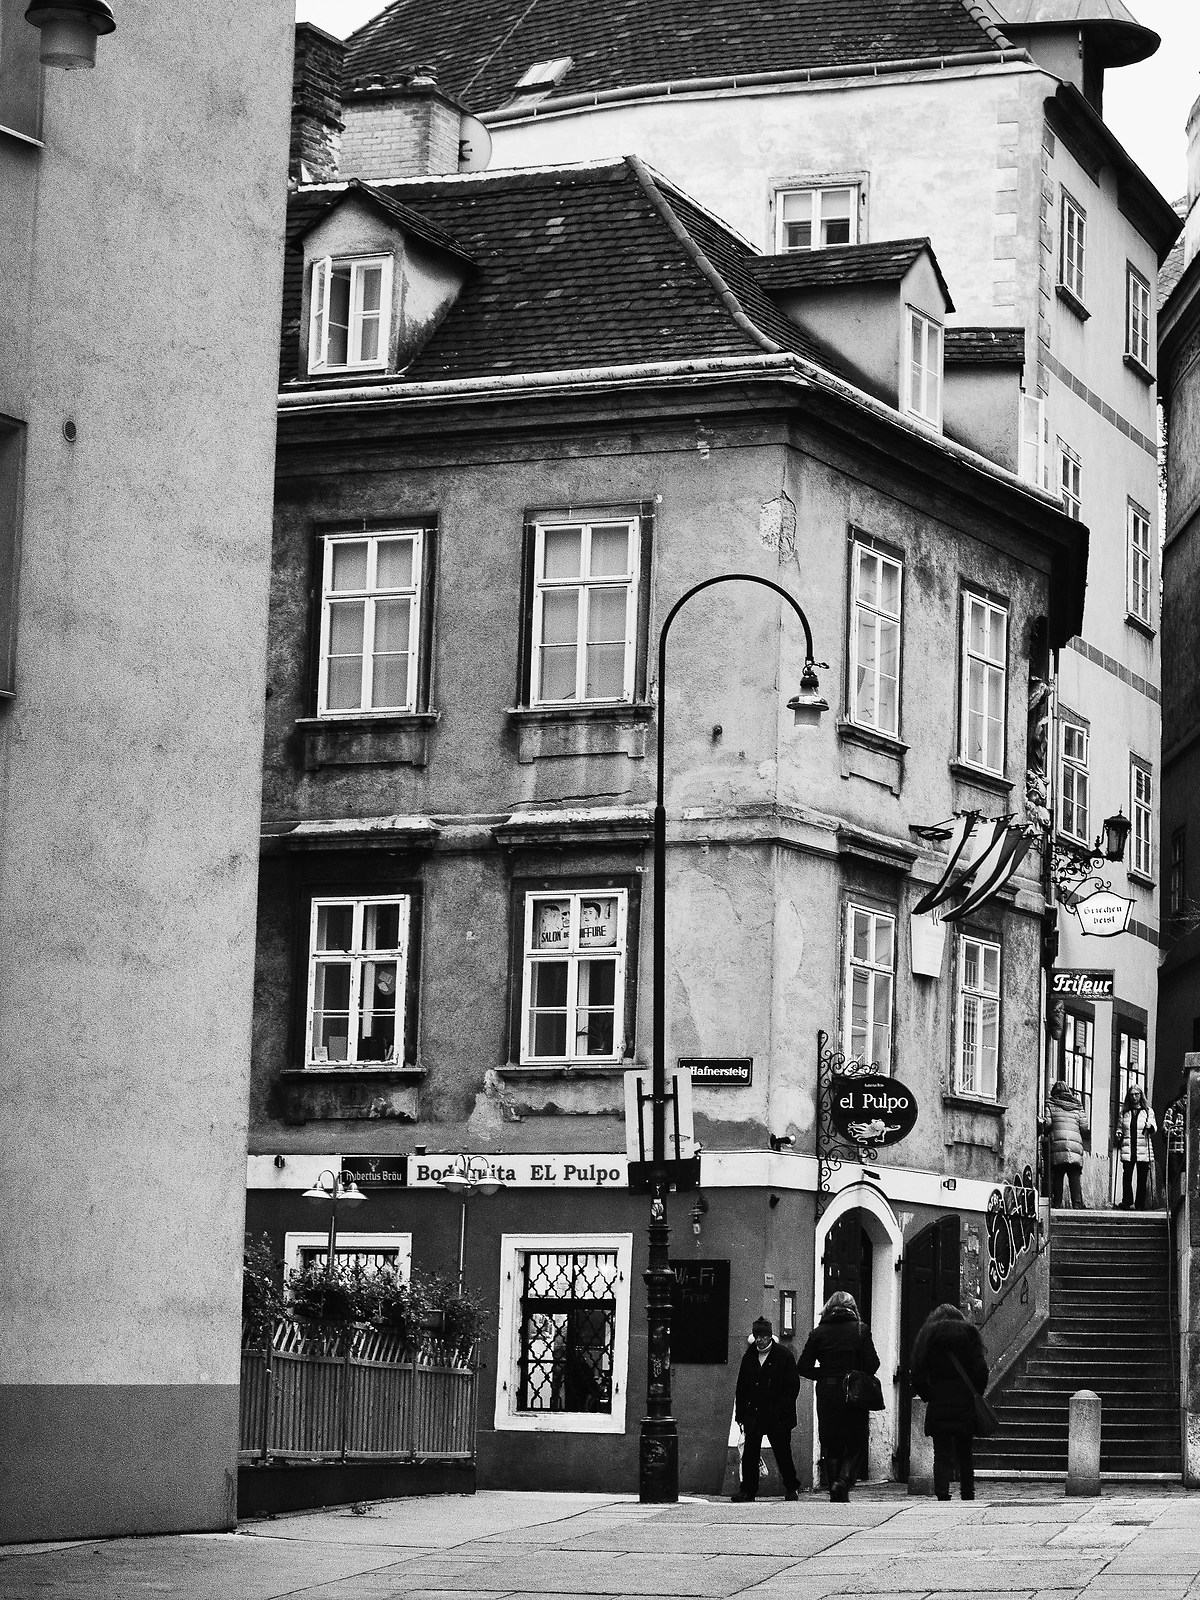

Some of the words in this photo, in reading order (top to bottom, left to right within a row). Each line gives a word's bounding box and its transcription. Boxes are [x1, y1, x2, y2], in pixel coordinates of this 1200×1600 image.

[541, 931, 562, 943] SALON
[690, 1065, 749, 1079] Hafnersteig
[839, 1092, 855, 1110] el
[862, 1092, 909, 1114] Pulpo
[530, 1164, 557, 1181] EL
[563, 1163, 621, 1185] Pulpo
